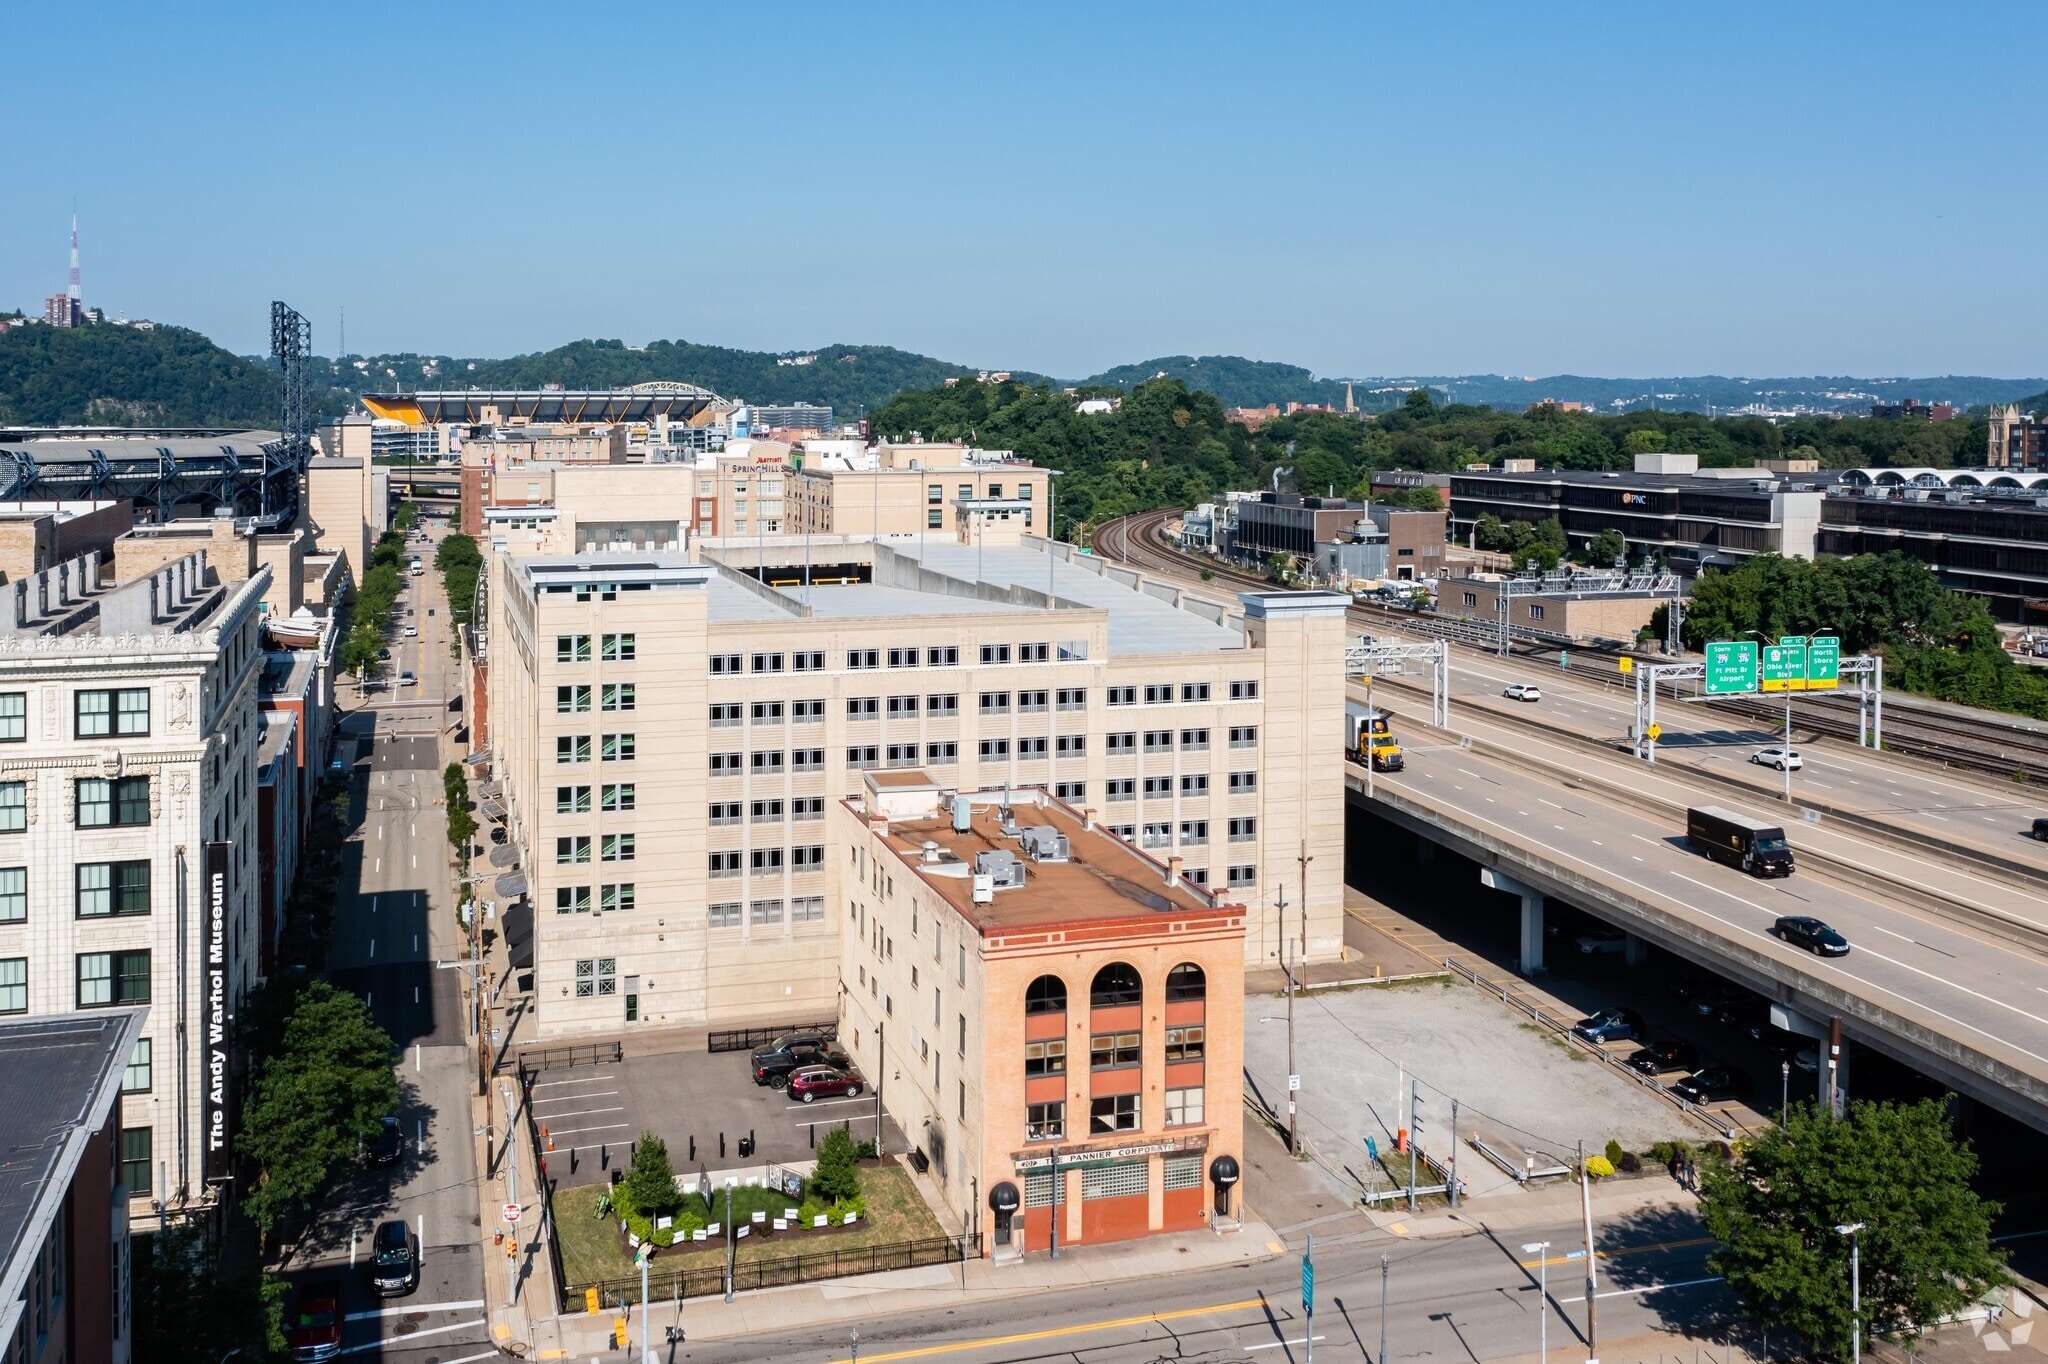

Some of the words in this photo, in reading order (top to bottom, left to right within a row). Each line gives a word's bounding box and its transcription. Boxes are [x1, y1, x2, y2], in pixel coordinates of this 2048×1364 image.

[1631, 494, 1646, 504] PNC
[1719, 675, 1745, 683] Airport
[209, 873, 223, 964] Museum
[210, 969, 223, 1044] Warhol
[210, 1050, 226, 1104] Andy
[210, 1110, 223, 1151] The
[1045, 1157, 1063, 1165] TE
[1070, 1151, 1112, 1161] PANNIER
